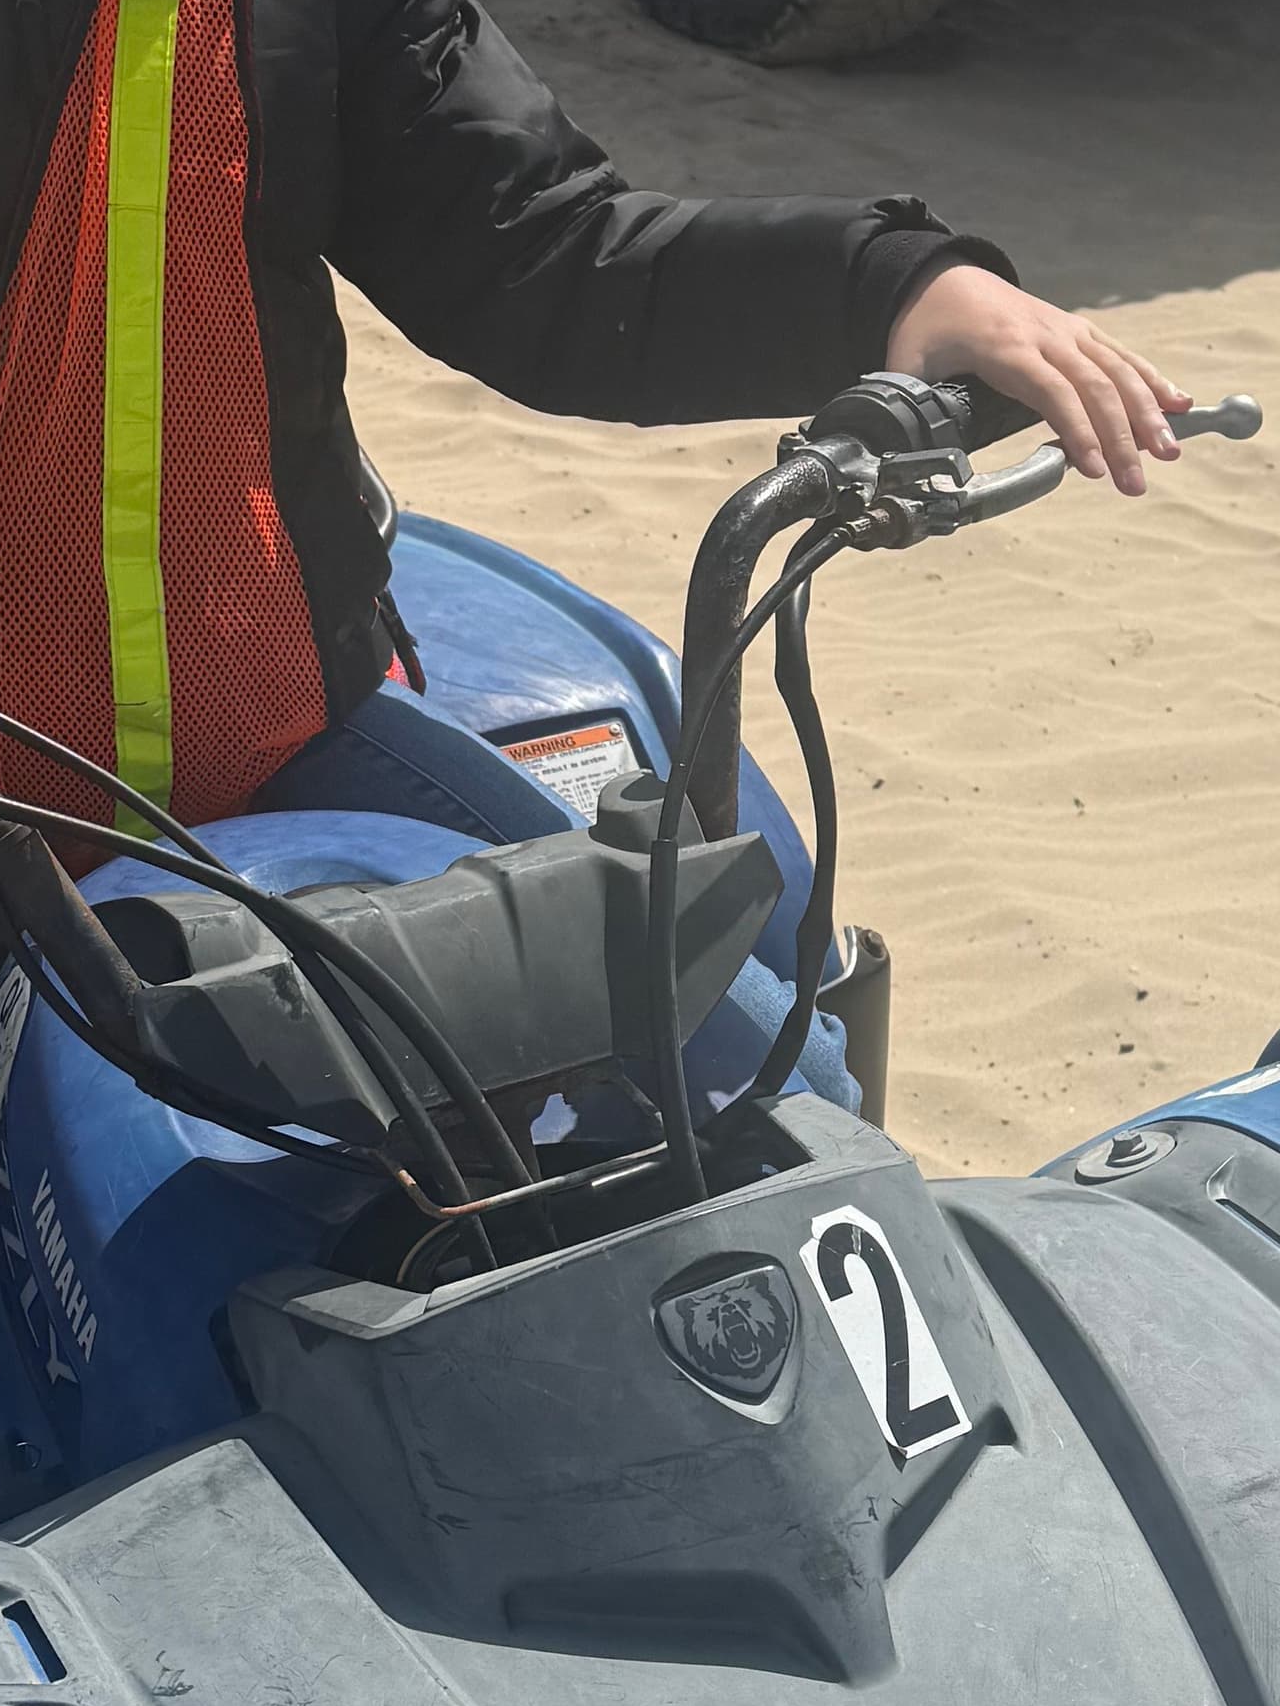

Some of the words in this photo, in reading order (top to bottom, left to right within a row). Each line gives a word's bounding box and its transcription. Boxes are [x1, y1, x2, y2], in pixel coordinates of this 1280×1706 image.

[508, 735, 577, 760] WARNING
[30, 1168, 99, 1365] YAMAHA
[817, 1222, 961, 1448] 2
